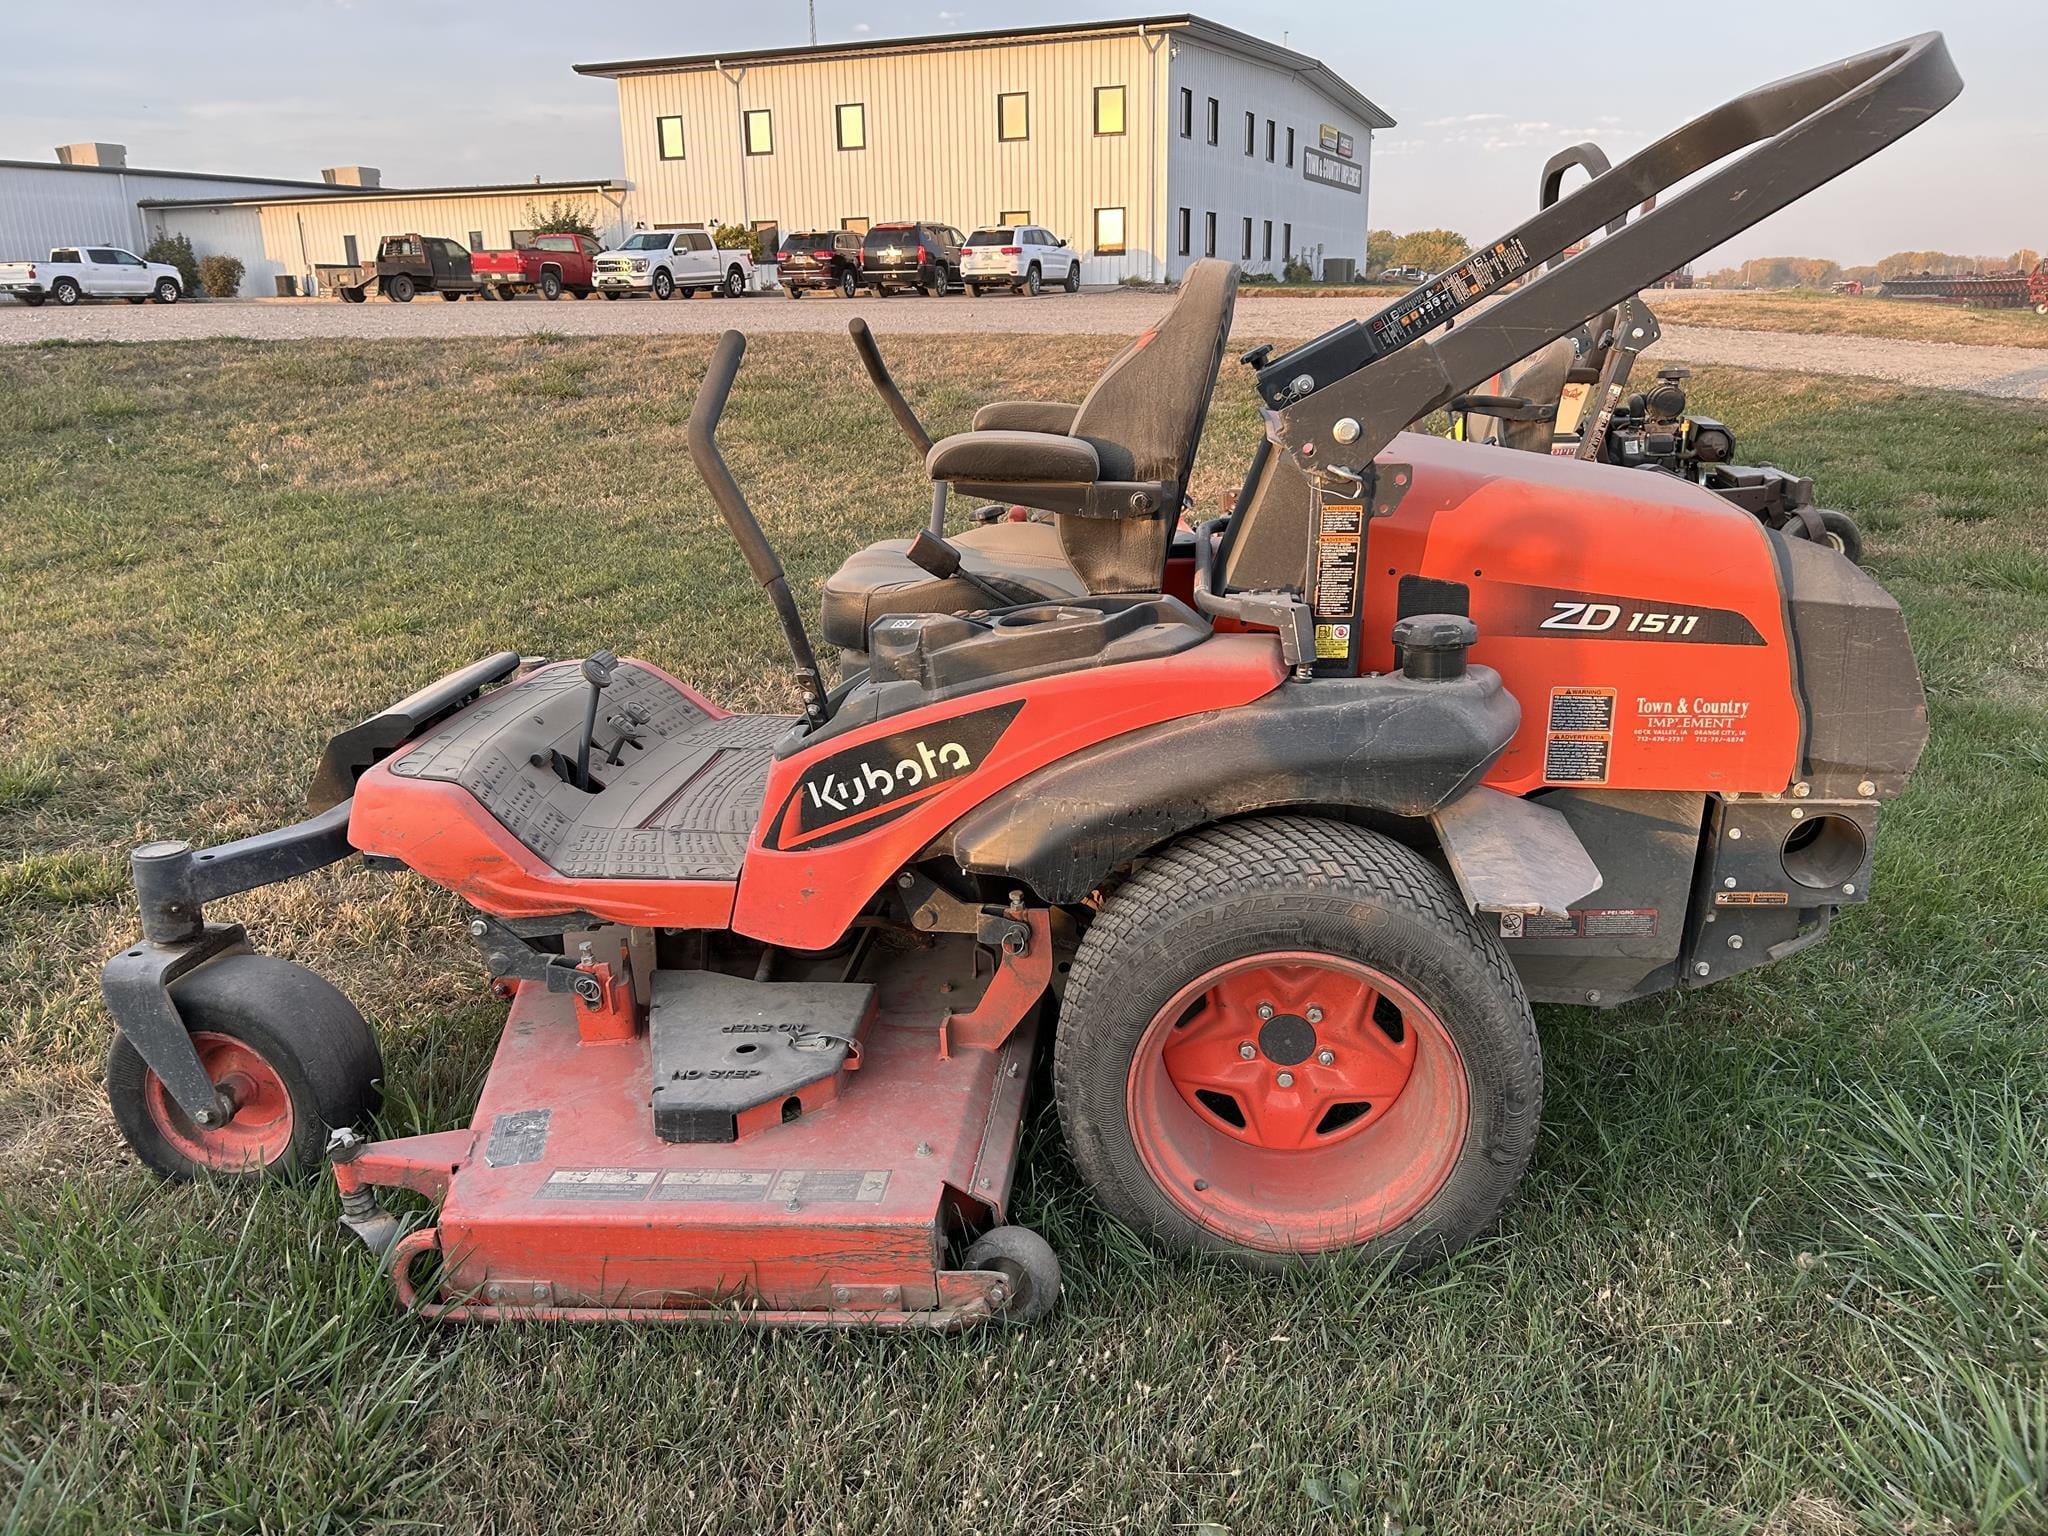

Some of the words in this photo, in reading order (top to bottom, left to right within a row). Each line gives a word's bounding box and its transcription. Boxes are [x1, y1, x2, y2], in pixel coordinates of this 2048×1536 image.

[1540, 602, 1621, 631] ZD
[1626, 612, 1699, 635] 1511
[1636, 697, 1672, 714] Town
[1677, 697, 1689, 714] &
[1693, 697, 1750, 718] Country
[807, 741, 971, 811] Kubota
[1223, 896, 1375, 922] MASTER
[671, 1069, 703, 1081] NO
[706, 1069, 762, 1080] STEP
